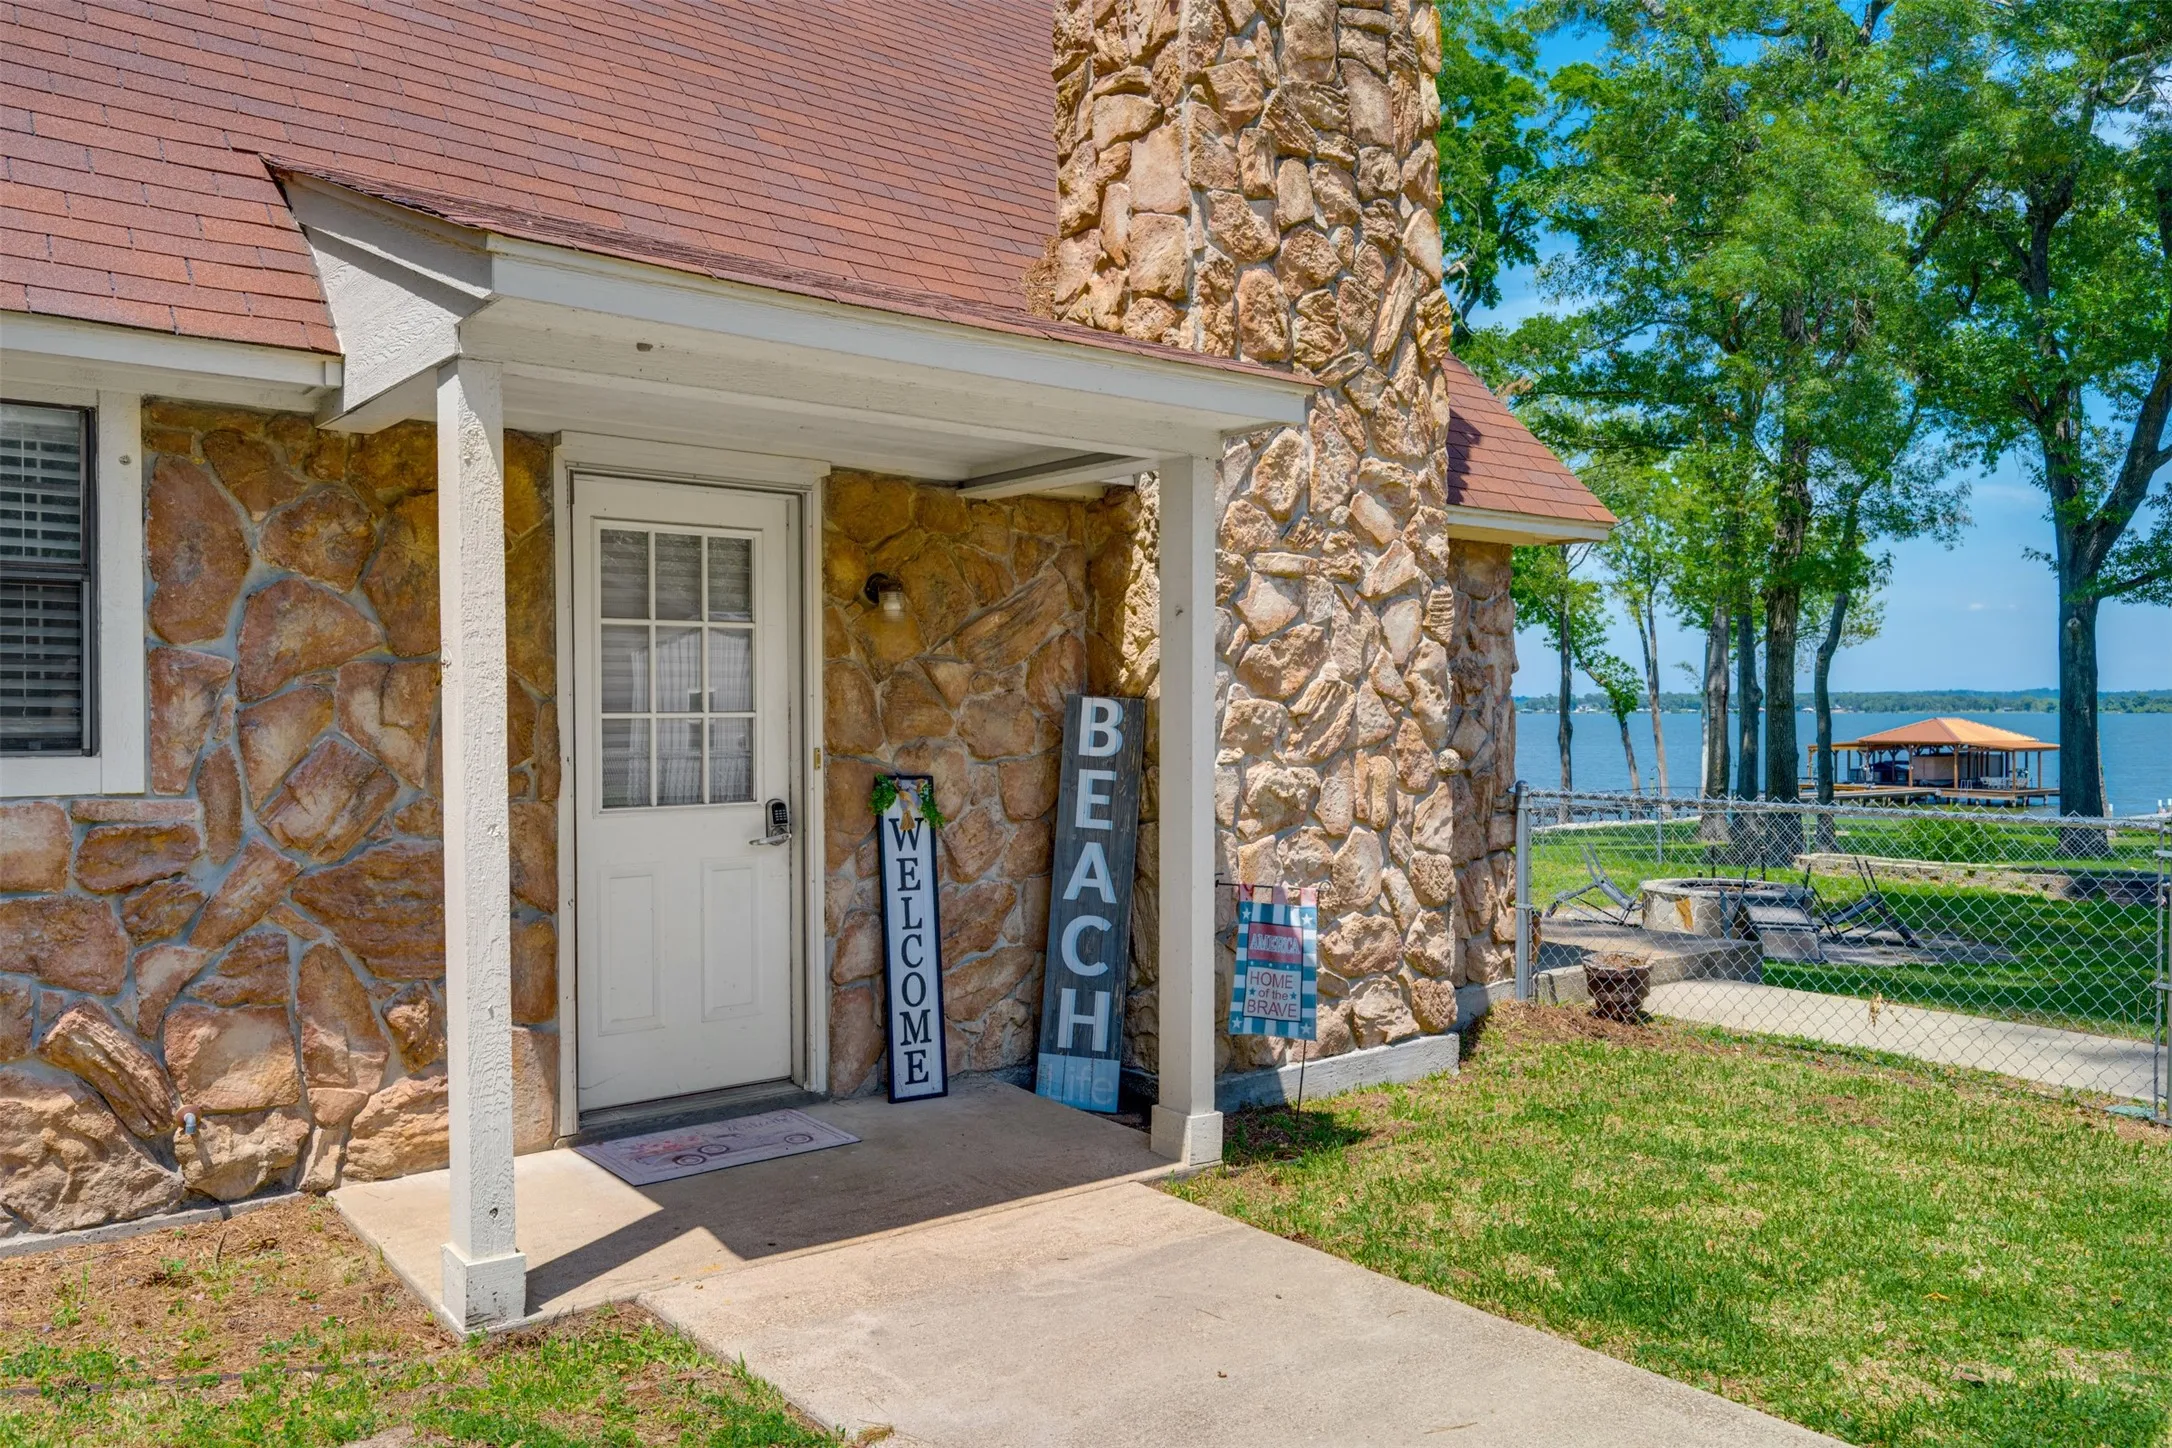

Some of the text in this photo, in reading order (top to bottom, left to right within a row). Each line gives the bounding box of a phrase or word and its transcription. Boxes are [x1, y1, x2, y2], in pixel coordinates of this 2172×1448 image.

[1057, 697, 1124, 1052] BEACH
[888, 817, 932, 1086] WELCOME
[1249, 932, 1301, 955] AMERICA
[1249, 971, 1294, 989] HOME
[1258, 988, 1289, 1001] of the
[1246, 999, 1297, 1018] BRAVE
[1047, 1063, 1114, 1105] Life
